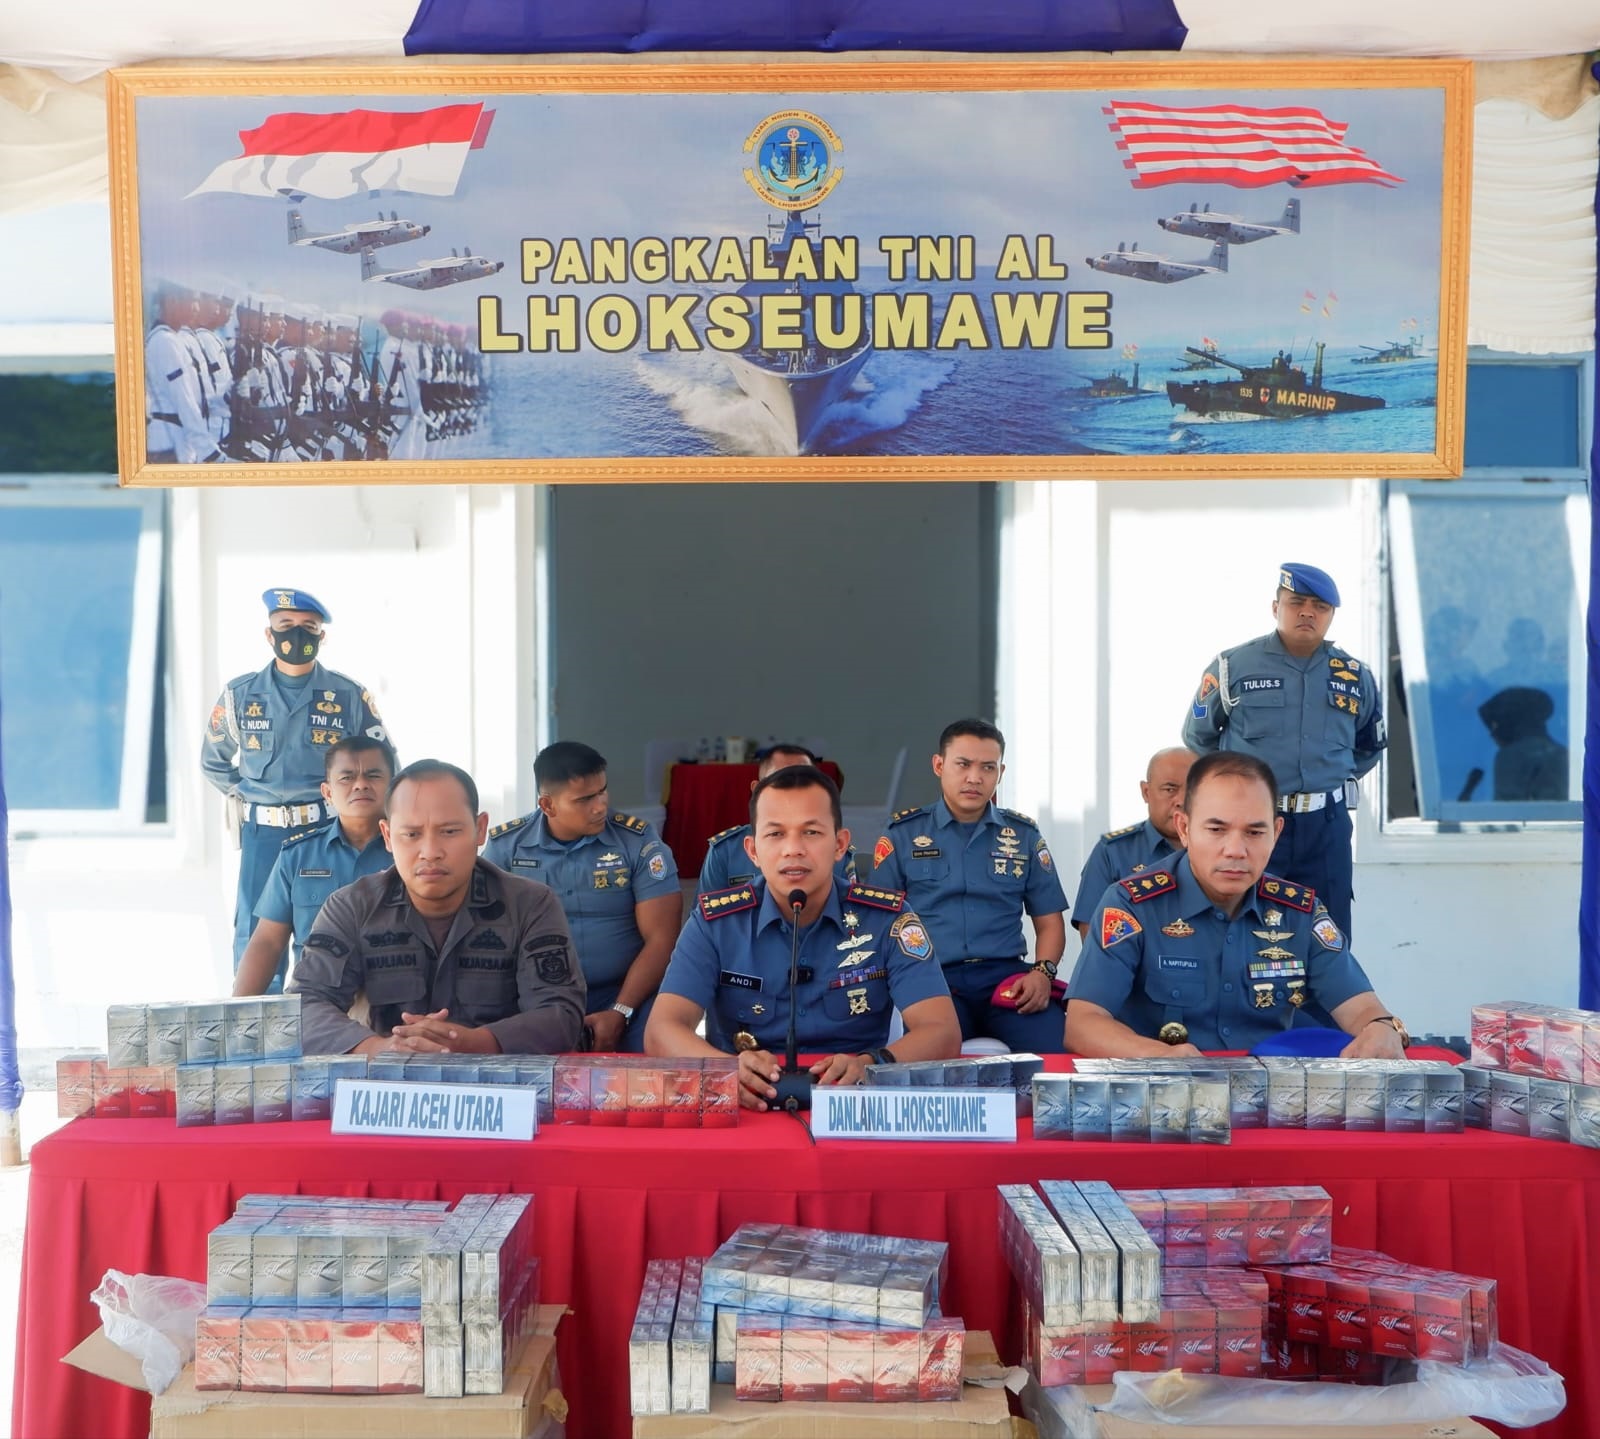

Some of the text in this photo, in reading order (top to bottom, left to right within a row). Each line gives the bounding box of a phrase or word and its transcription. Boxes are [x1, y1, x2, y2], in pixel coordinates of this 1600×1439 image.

[520, 235, 1068, 283] PANGKALAN TNI AL
[476, 291, 1113, 354] LHOKSEUMAWE
[1277, 389, 1336, 411] MARINIR
[1243, 680, 1280, 691] TULUS.S
[1330, 681, 1361, 697] TNI AL
[247, 719, 270, 730] NUDIN
[311, 715, 344, 729] TNI AL
[730, 976, 753, 987] ANDI
[349, 1090, 503, 1133] KAJARI ACEH UTARA
[828, 1095, 987, 1132] DANLANAL LHOKSEUMAWE
